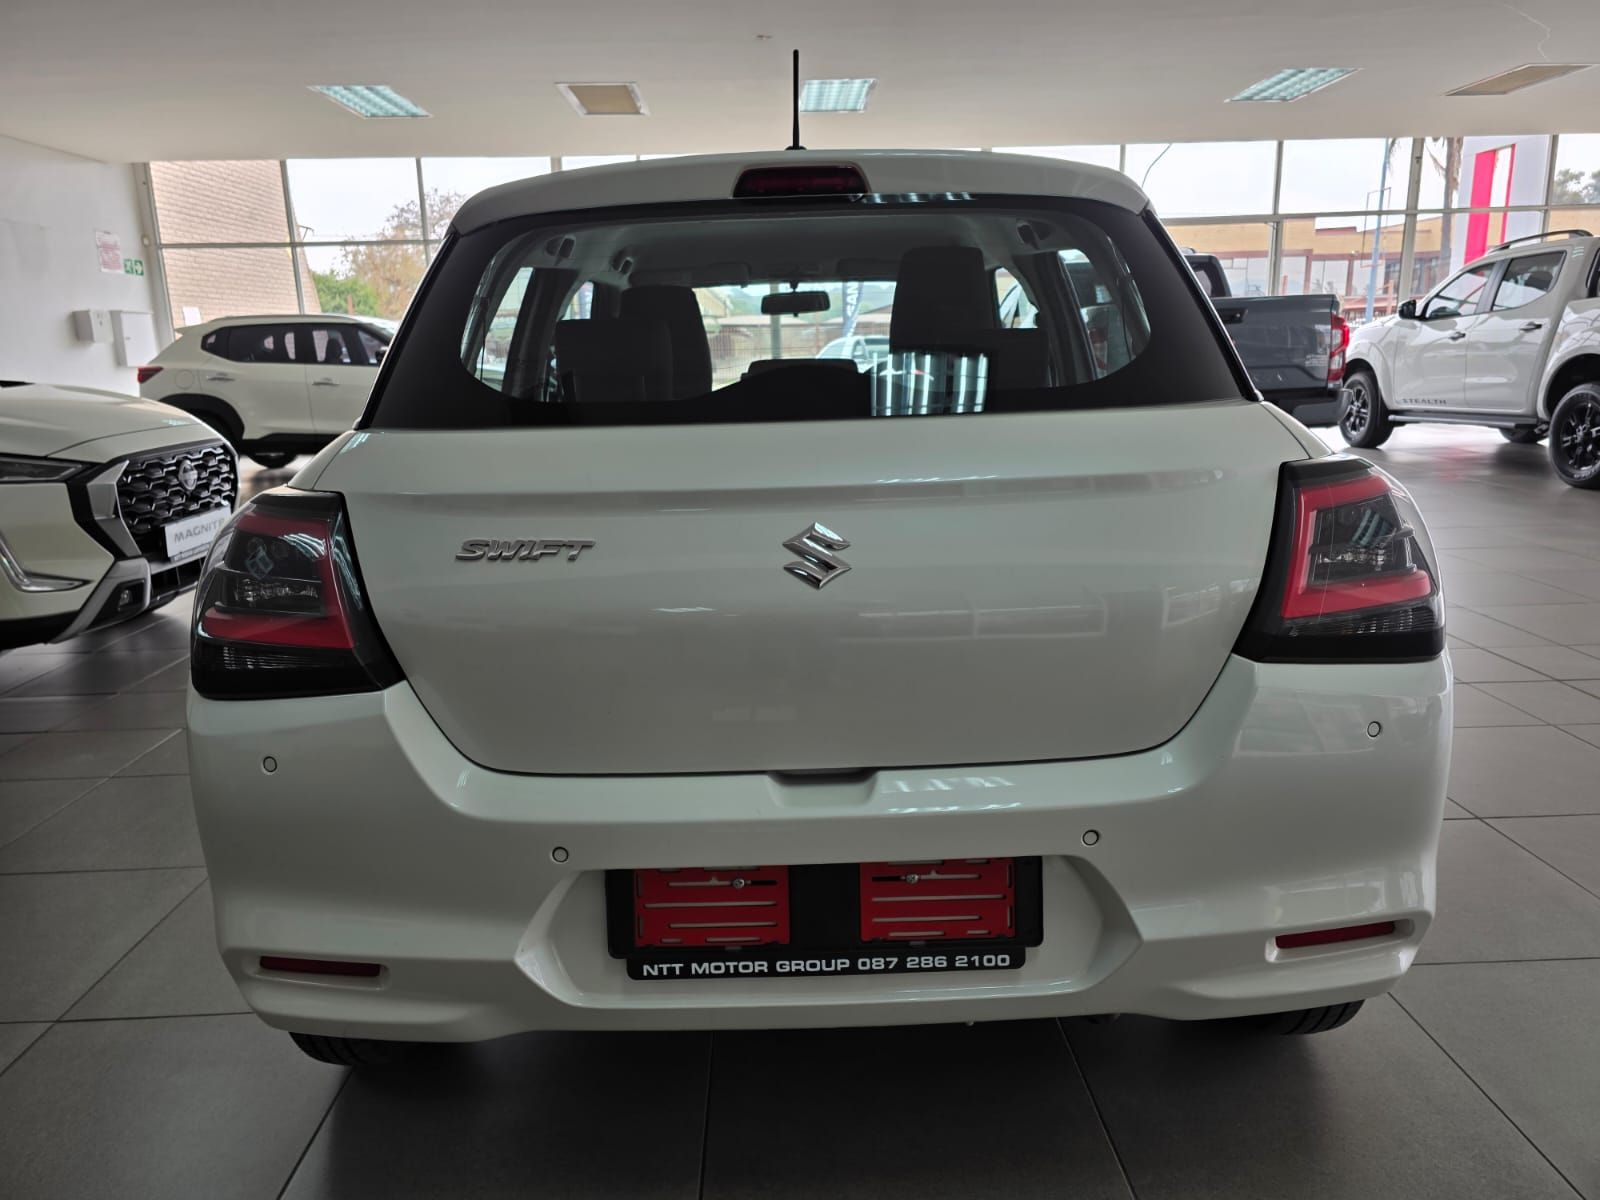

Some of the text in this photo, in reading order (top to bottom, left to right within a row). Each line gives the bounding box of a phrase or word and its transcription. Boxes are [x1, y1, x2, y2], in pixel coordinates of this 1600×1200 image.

[455, 538, 595, 561] SWIFT
[643, 954, 1010, 976] NTT MOTOR GROUP 087 286 2100
